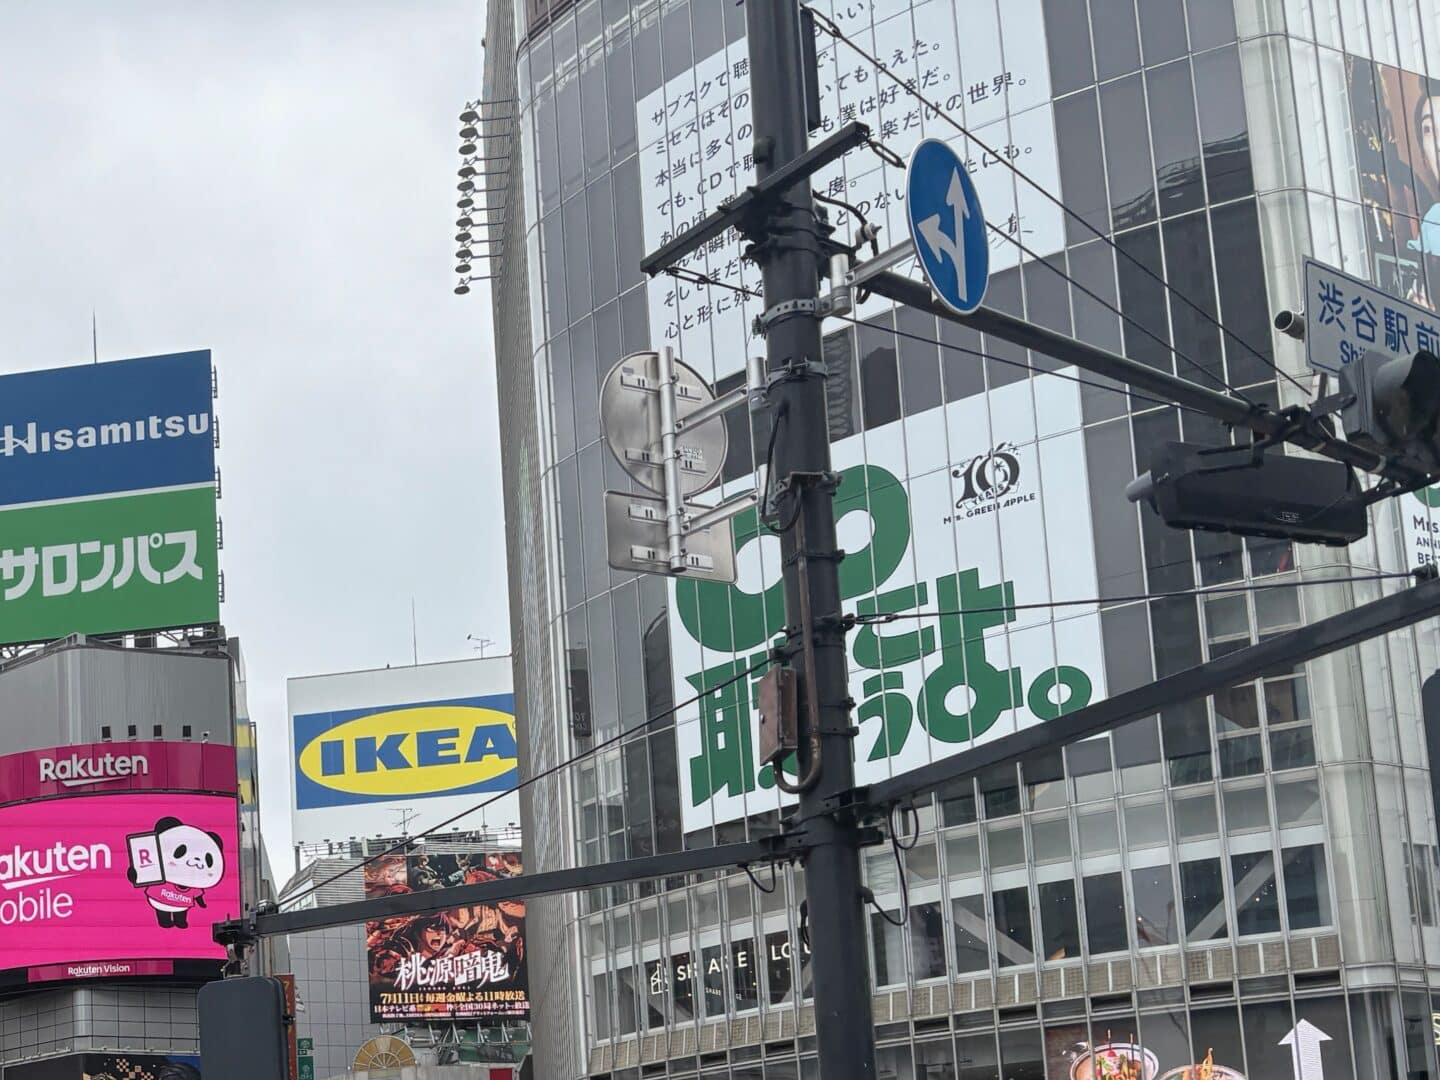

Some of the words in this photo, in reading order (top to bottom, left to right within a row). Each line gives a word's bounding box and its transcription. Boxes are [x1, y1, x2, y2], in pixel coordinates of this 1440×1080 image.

[655, 92, 750, 155] ミセスはその
[655, 123, 753, 187] 本当に多くの
[1318, 280, 1440, 361] 渋谷駅前
[966, 502, 1001, 518] GREEN
[1003, 493, 1036, 508] APPLE
[40, 753, 148, 784] Rakuten
[321, 723, 517, 777] IKEA
[160, 888, 192, 904] Rakuten
[68, 965, 102, 976] Rakuten
[103, 963, 130, 974] Vision
